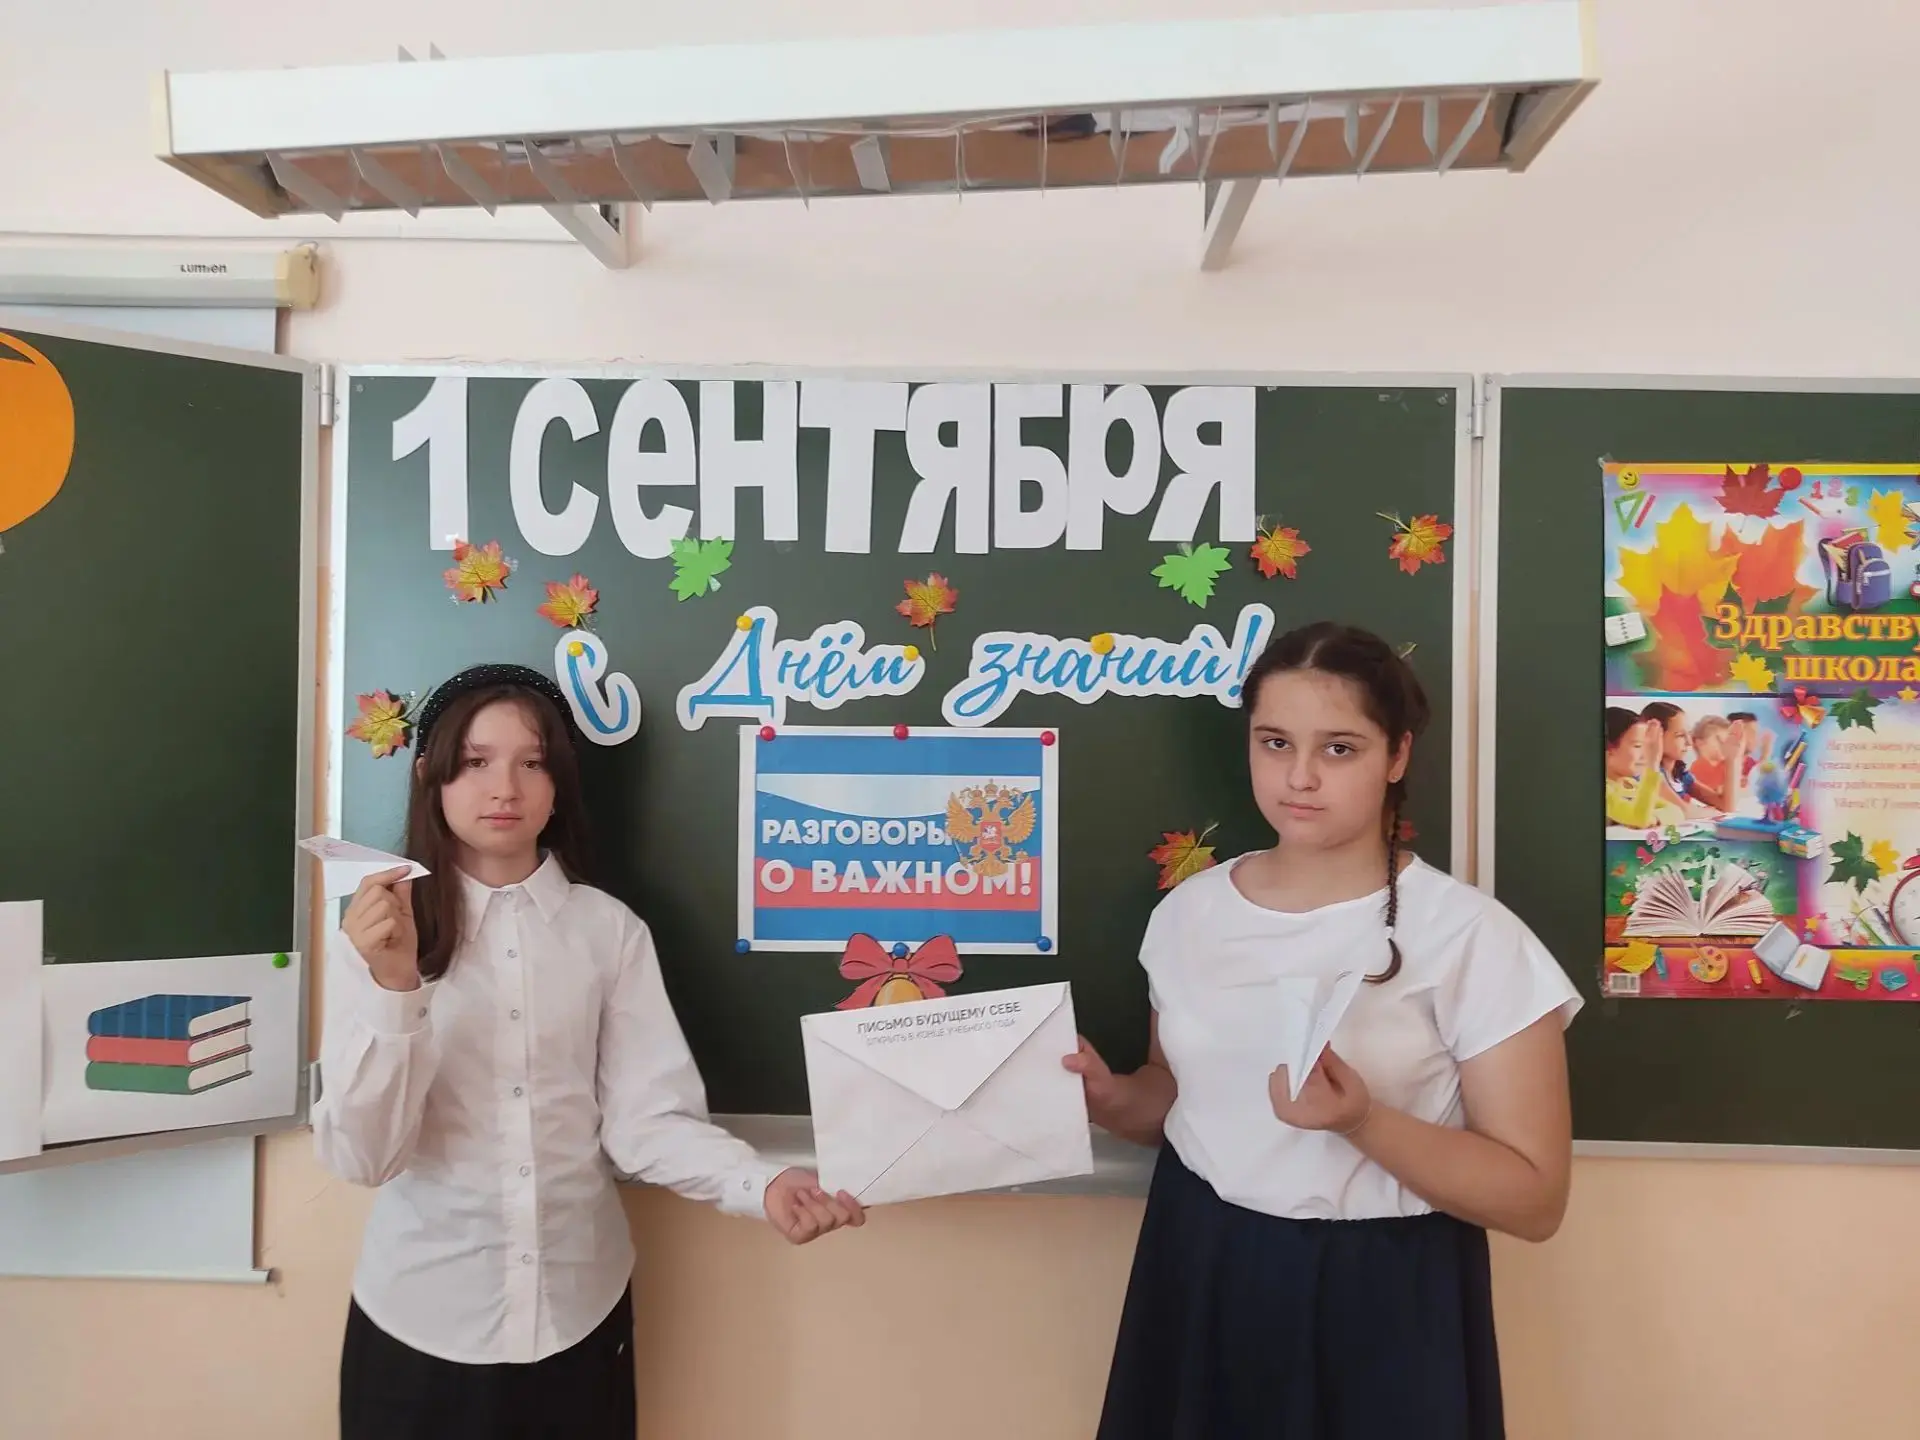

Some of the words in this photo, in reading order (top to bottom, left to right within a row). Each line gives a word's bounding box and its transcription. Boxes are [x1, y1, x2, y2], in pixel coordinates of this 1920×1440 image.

[393, 376, 468, 551] 1
[566, 641, 630, 735] С
[689, 617, 917, 720] Днём
[953, 614, 1263, 718] знаний!
[761, 819, 953, 846] РАЗГОВОРЫ
[760, 859, 795, 893] О
[811, 860, 1032, 897] ВАЖНОМ!
[857, 1015, 913, 1034] ПИСЬМО
[916, 1006, 986, 1026] БУДУЩЕМУ
[989, 1001, 1022, 1016] СЕБЕ
